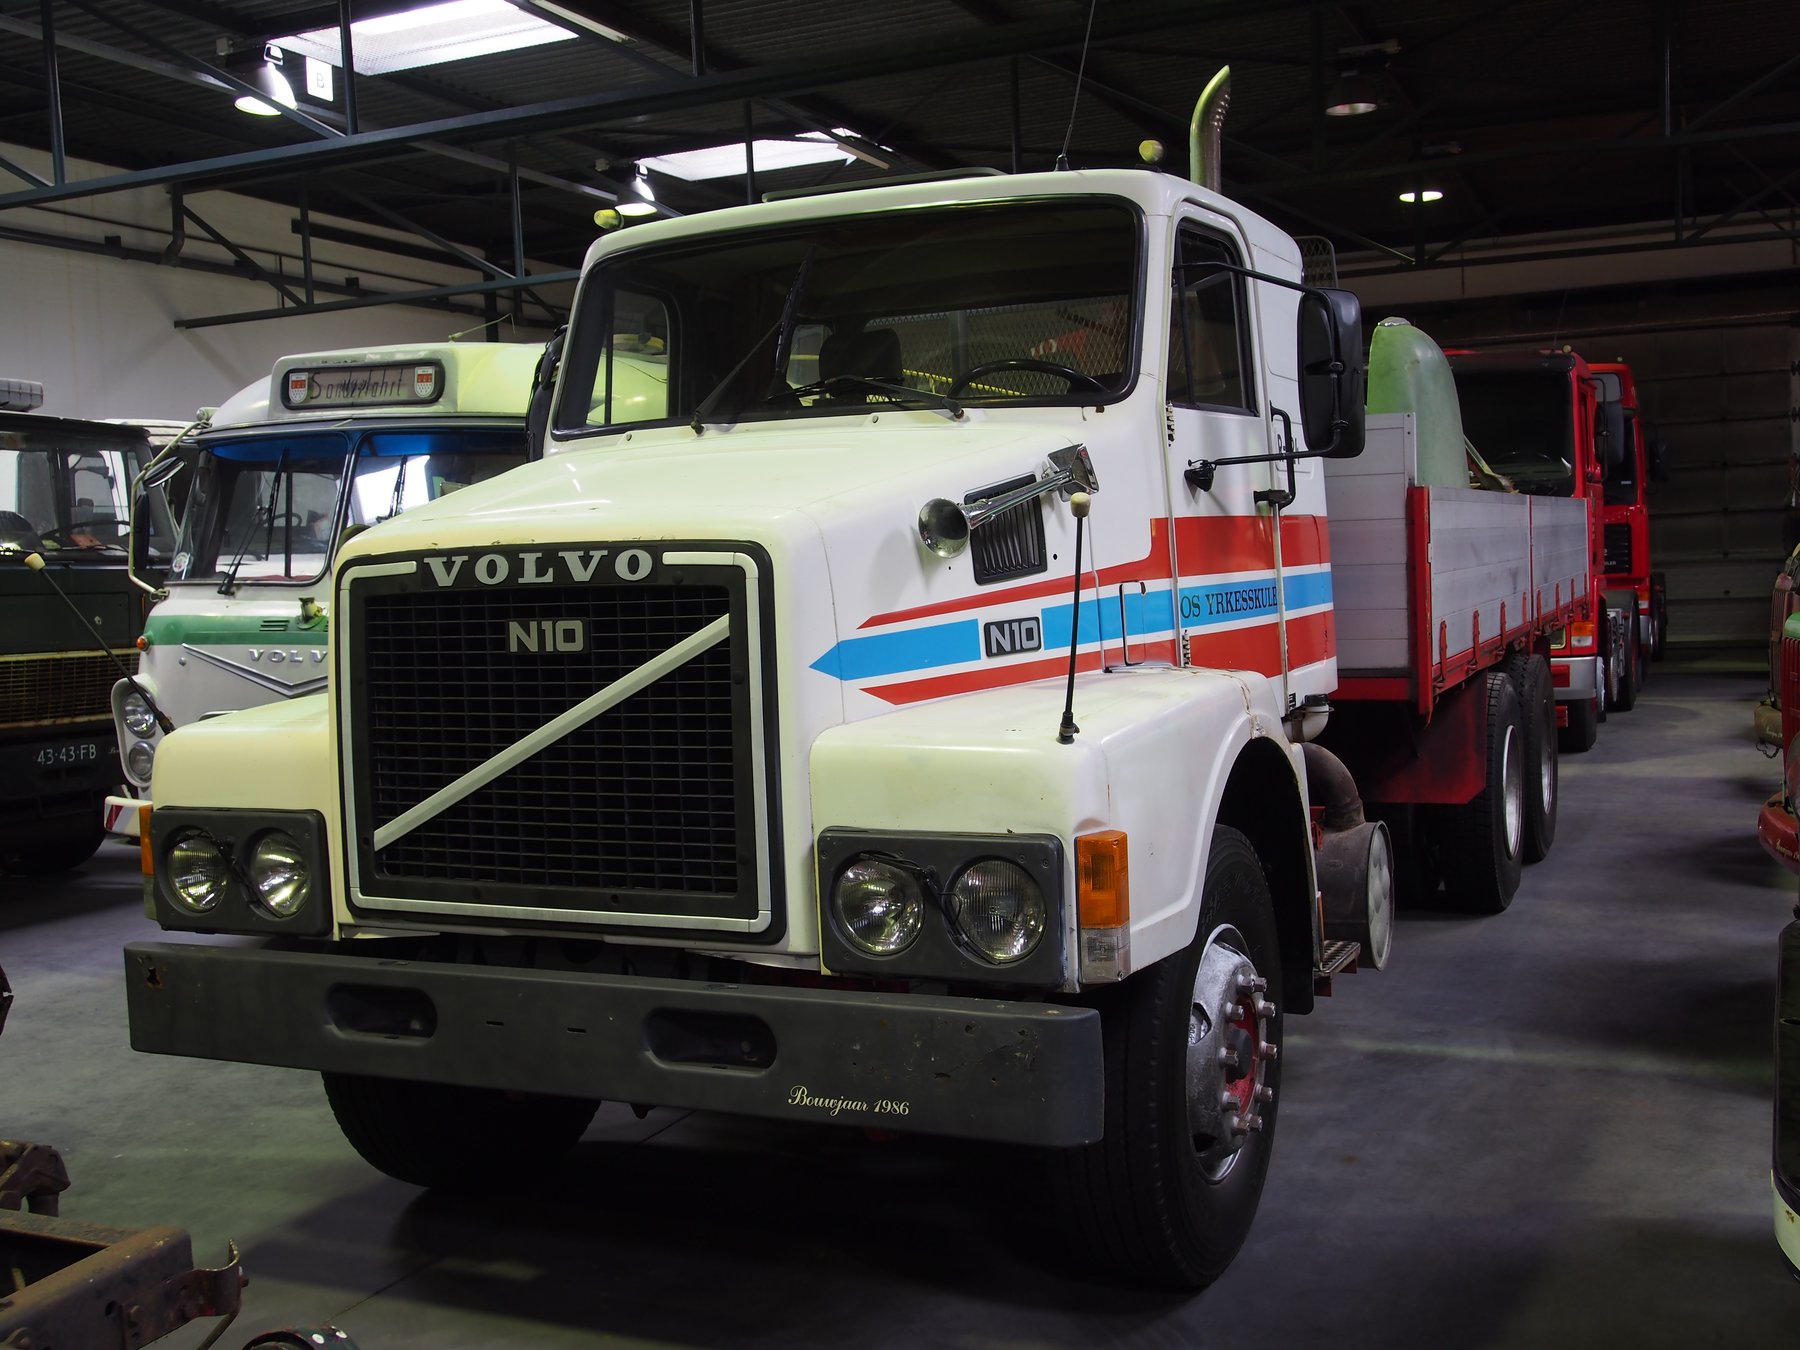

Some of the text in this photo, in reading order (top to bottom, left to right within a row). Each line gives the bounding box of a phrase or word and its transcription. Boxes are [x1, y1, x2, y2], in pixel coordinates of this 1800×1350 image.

[423, 549, 653, 587] VOLVO
[1180, 586, 1278, 619] OS YRKESSKULE
[509, 619, 584, 653] N10
[989, 619, 1039, 654] N10
[248, 648, 328, 664] VOLV
[787, 1085, 910, 1117] Bouwjaar 1986
